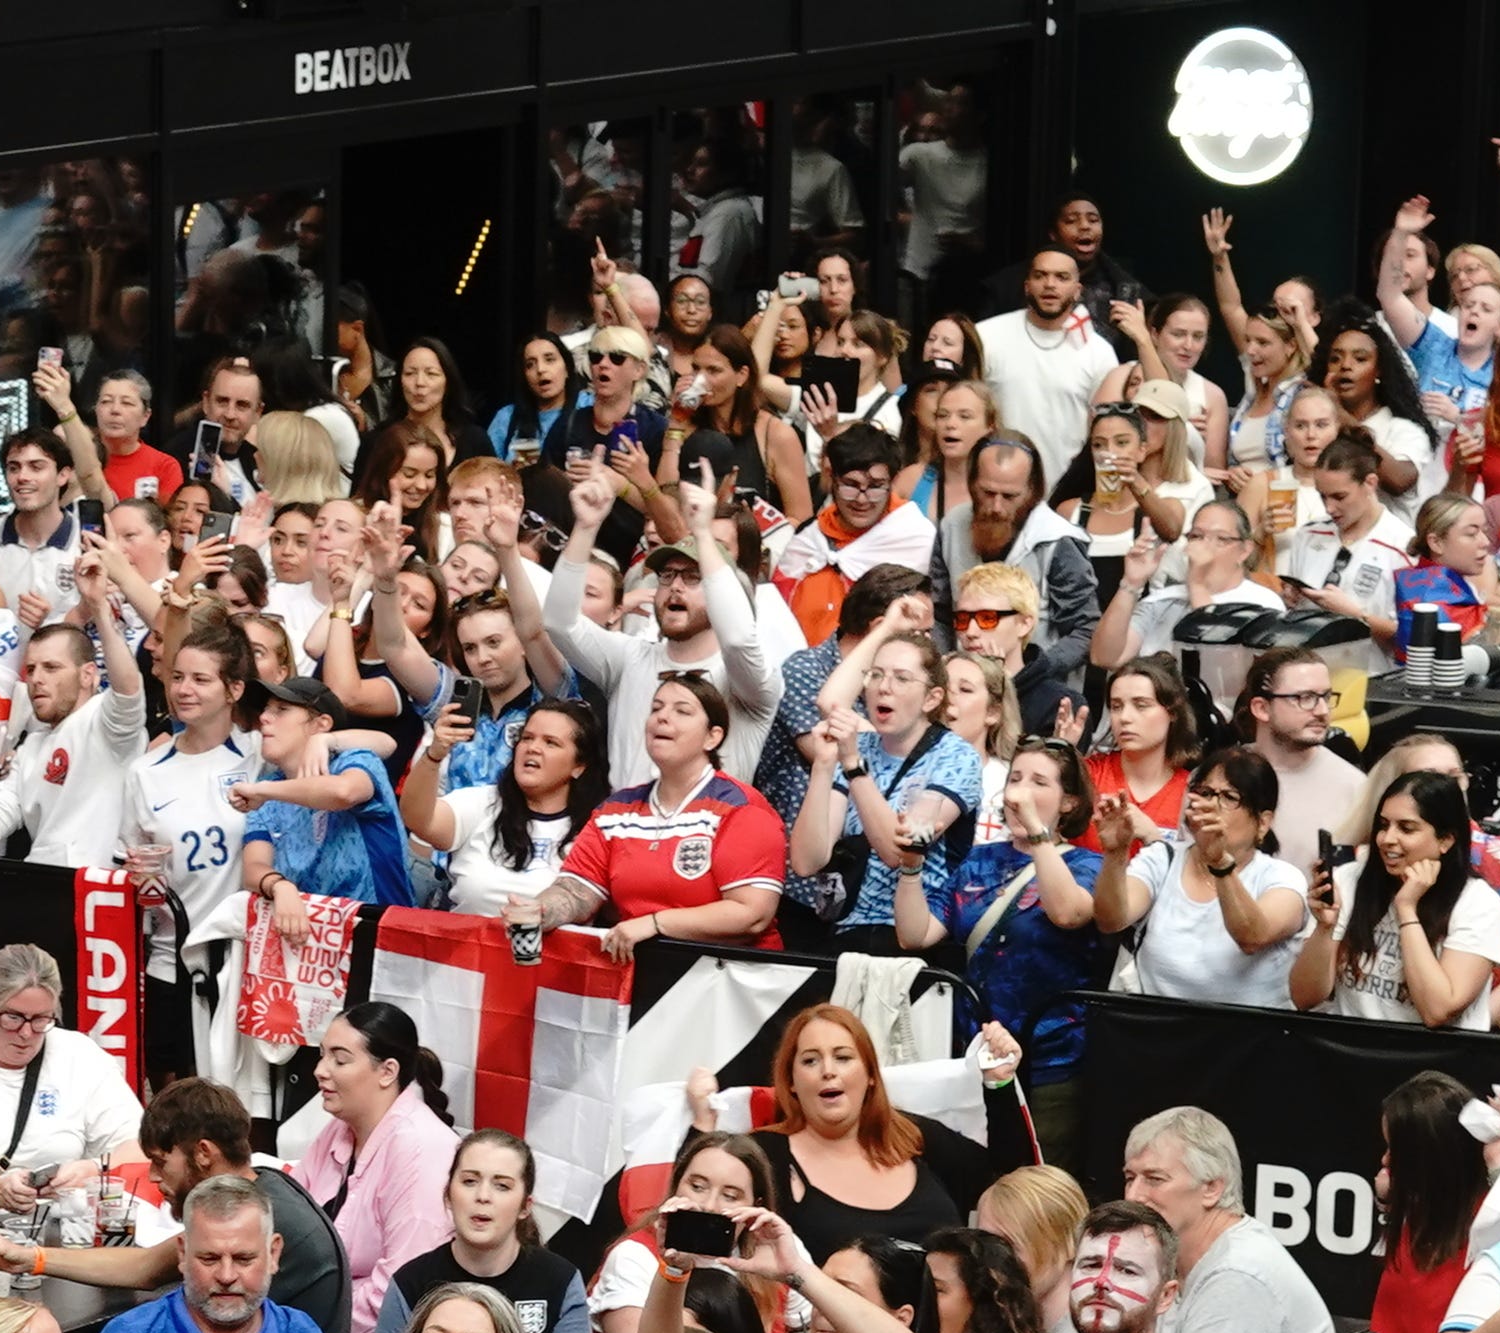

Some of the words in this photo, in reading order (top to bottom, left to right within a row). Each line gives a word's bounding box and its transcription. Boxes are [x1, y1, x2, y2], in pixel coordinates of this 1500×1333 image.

[295, 42, 411, 94] BEATBOX
[181, 826, 228, 872] 23
[83, 870, 130, 1095] LAN
[1255, 1162, 1390, 1260] BO
